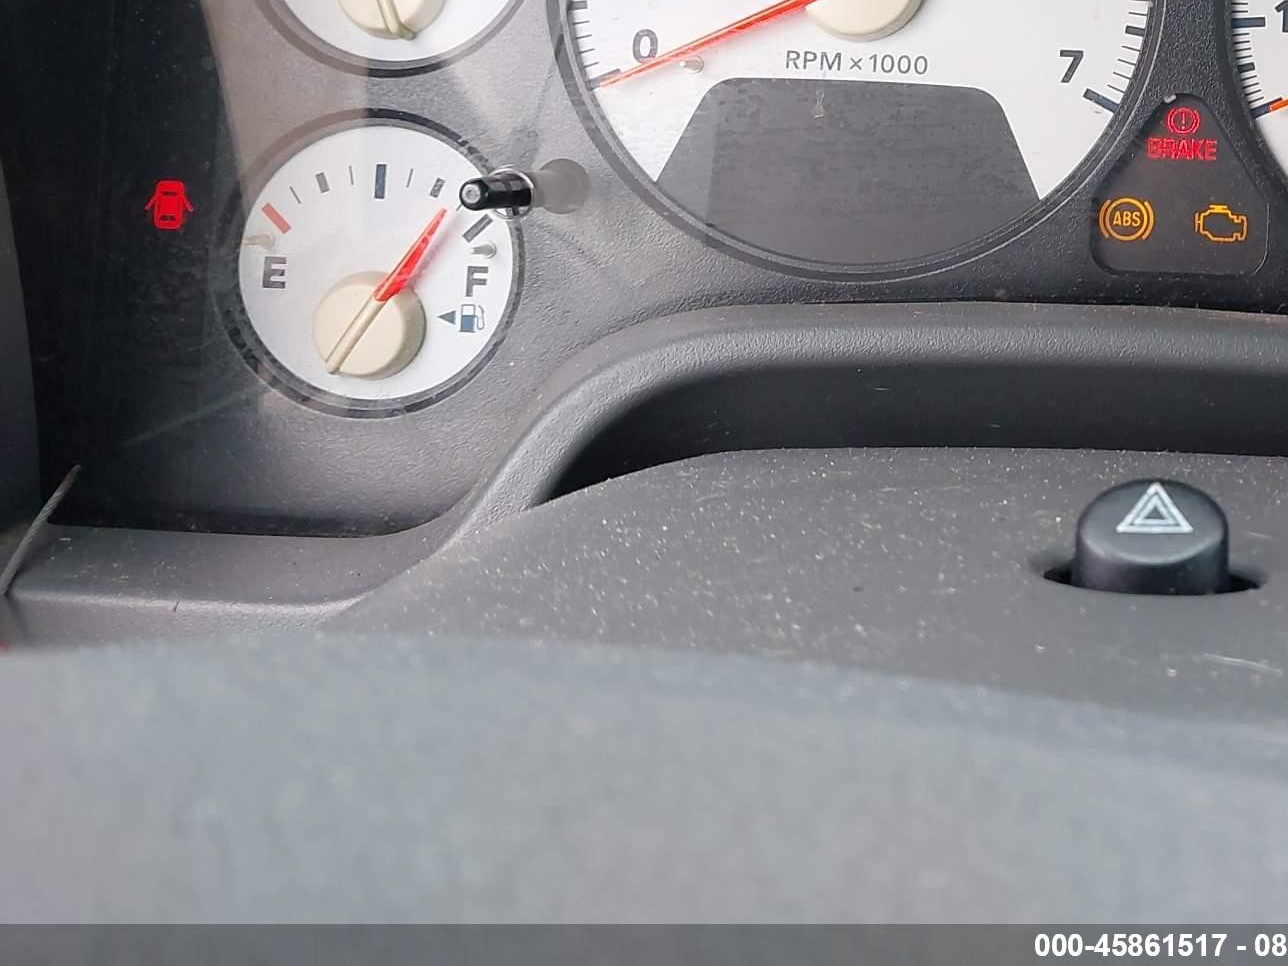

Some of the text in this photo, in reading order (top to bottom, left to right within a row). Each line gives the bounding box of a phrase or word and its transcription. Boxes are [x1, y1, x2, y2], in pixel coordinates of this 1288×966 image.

[633, 30, 658, 60] 0
[786, 50, 841, 71] RPM
[1060, 50, 1083, 83] 7
[1147, 137, 1218, 161] BRAKE
[1112, 210, 1141, 226] ABS
[262, 256, 286, 289] E
[466, 266, 488, 297] F
